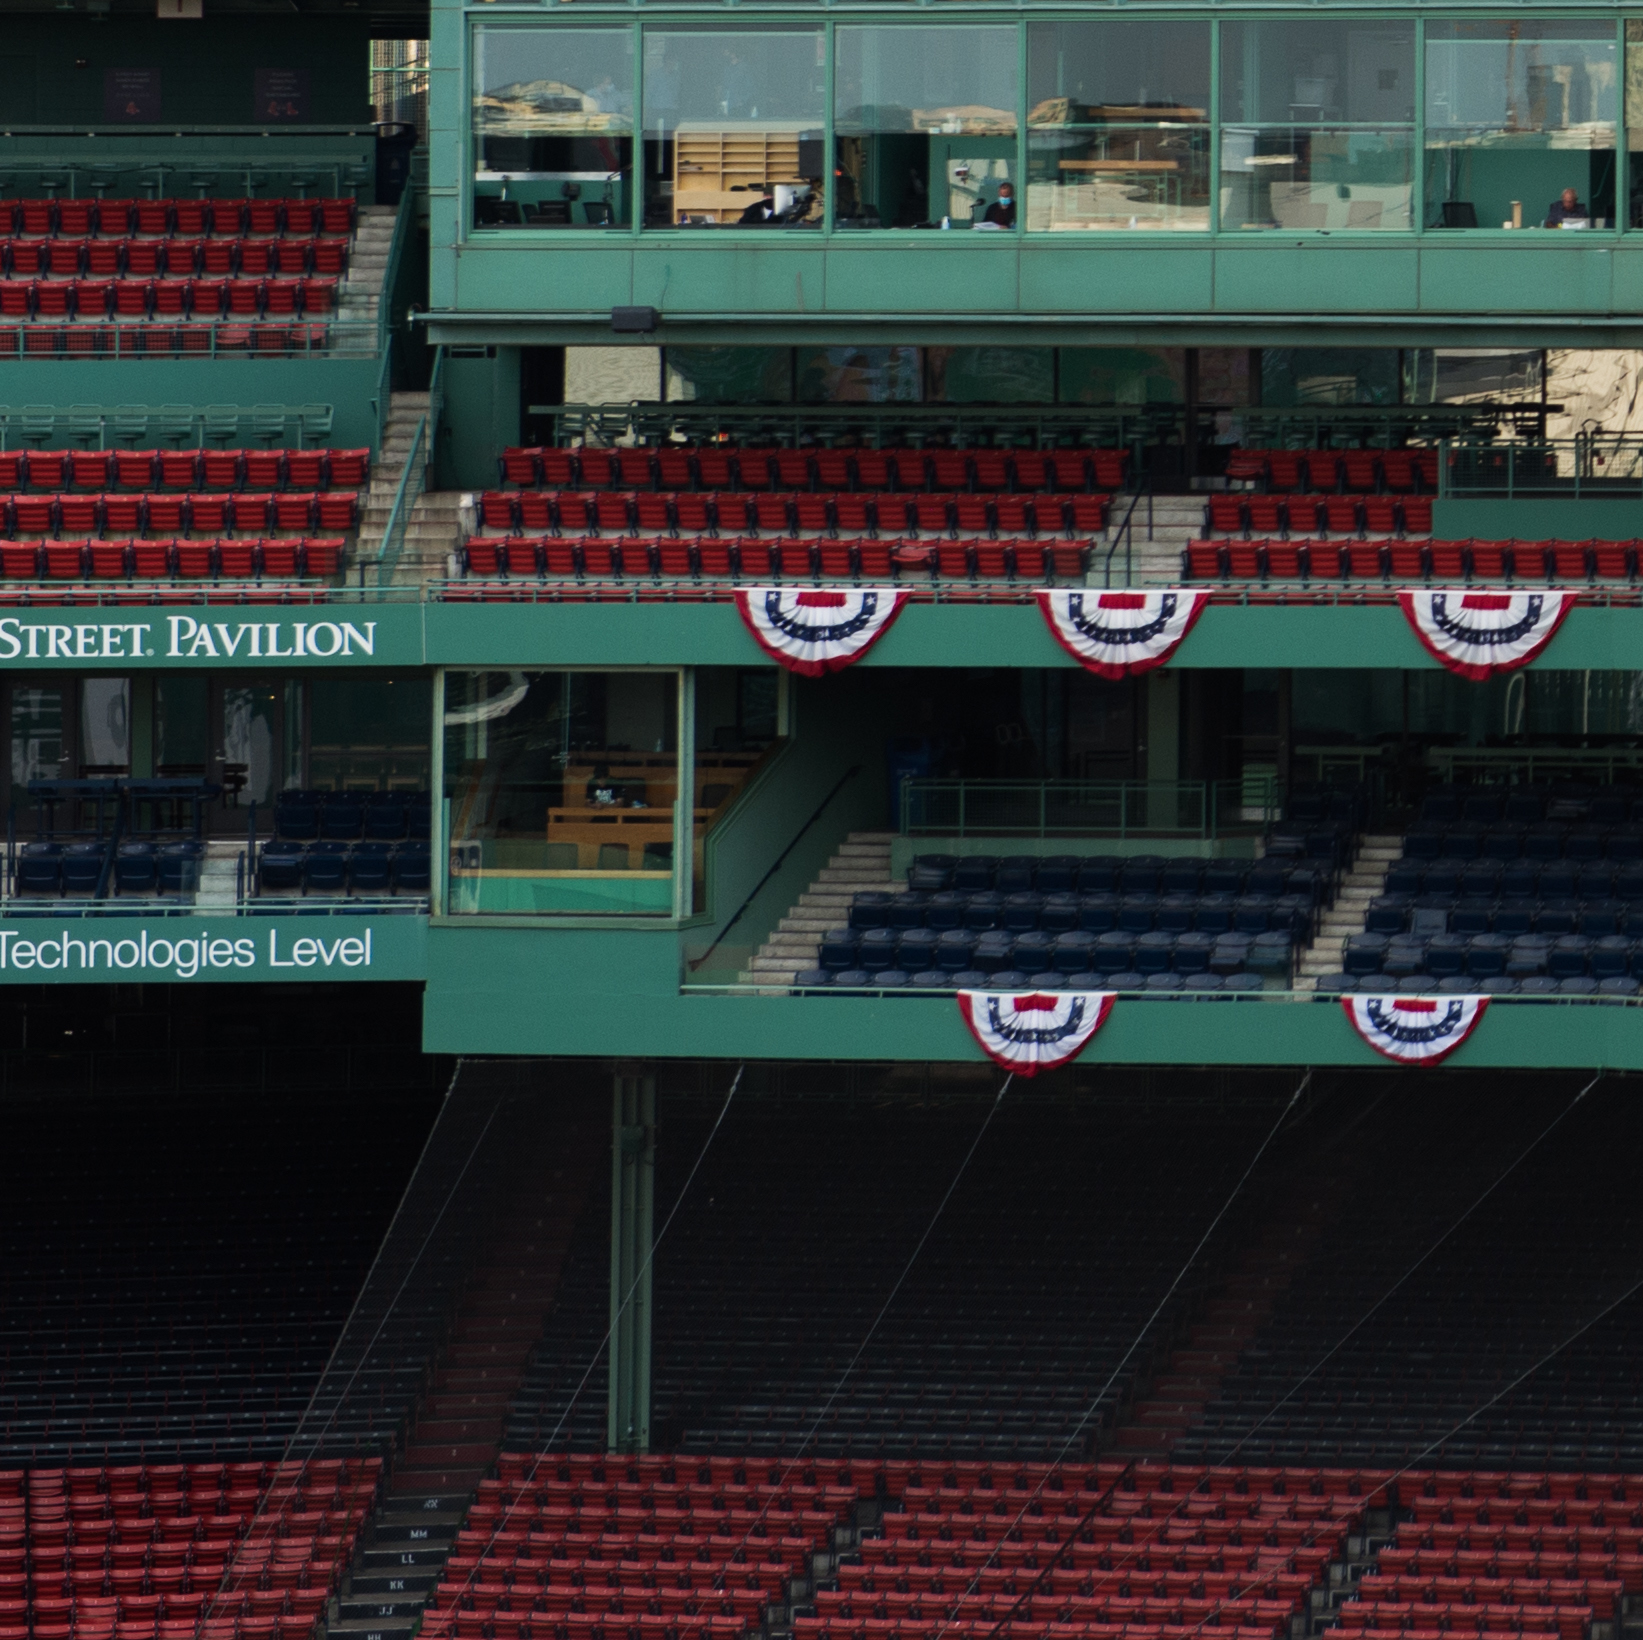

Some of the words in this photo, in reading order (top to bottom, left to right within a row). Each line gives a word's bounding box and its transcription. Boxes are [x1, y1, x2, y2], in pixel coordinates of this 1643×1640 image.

[0, 617, 151, 658] STREET
[165, 615, 377, 658] PAVILION
[0, 929, 256, 979] Technologies
[269, 928, 372, 967] Level
[410, 1529, 428, 1539] MM
[401, 1554, 415, 1564] LL
[390, 1580, 404, 1590] KK
